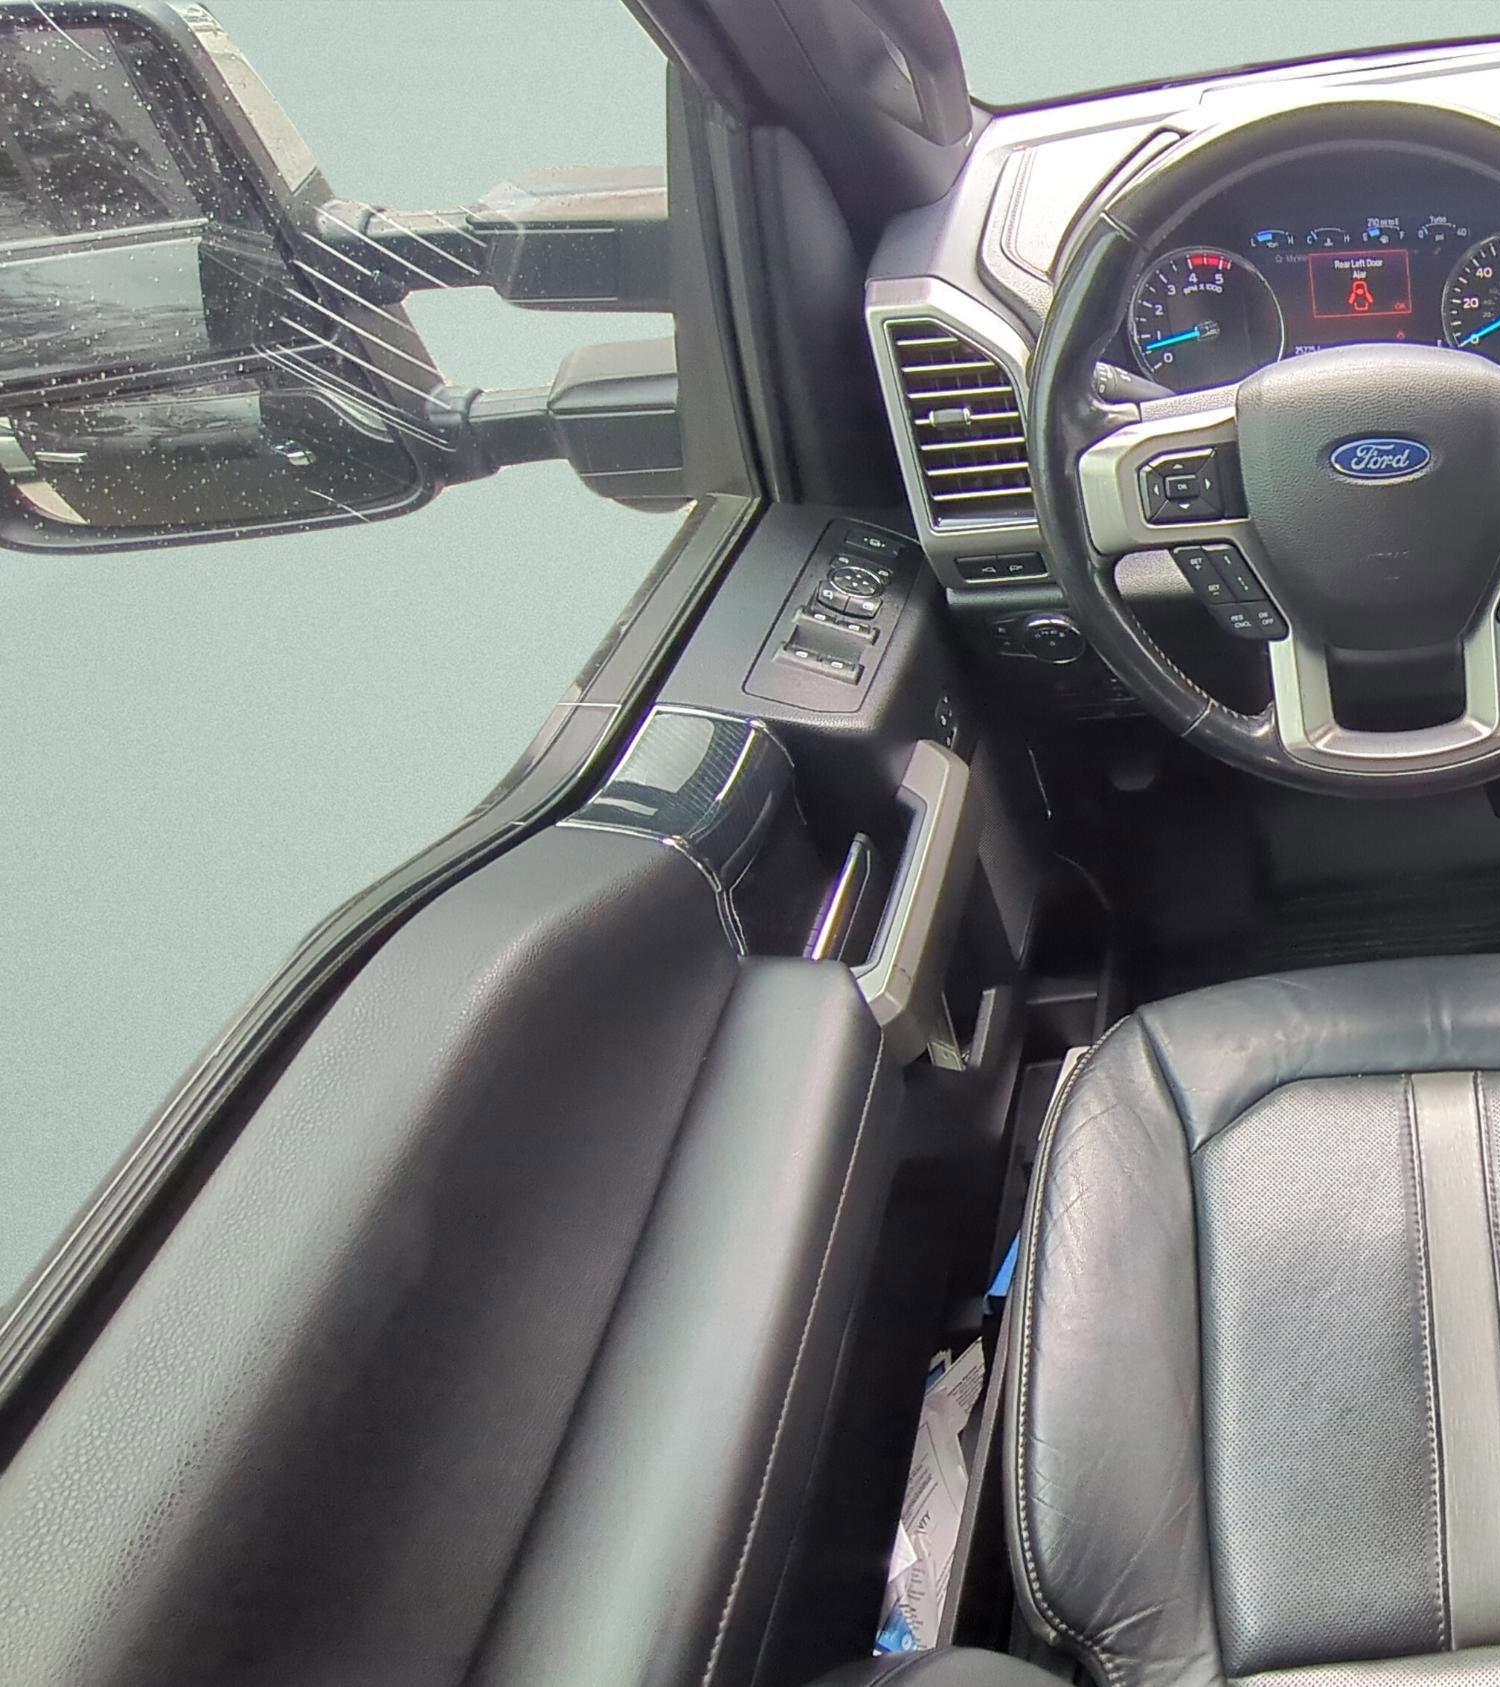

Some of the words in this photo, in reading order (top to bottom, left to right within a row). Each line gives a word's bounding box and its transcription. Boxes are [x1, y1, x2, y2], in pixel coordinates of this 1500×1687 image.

[1334, 260, 1350, 269] Rear
[1351, 259, 1365, 268] Left
[1366, 258, 1383, 267] Door
[1353, 270, 1367, 279] Ajar
[1475, 267, 1493, 278] 40
[1188, 273, 1198, 283] 4
[1215, 274, 1224, 284] 5
[1167, 285, 1176, 295] 3
[1463, 298, 1479, 309] 20
[1155, 305, 1163, 315] 2
[1470, 334, 1479, 344] 0
[1164, 353, 1173, 363] 0
[1351, 444, 1410, 470] Ford
